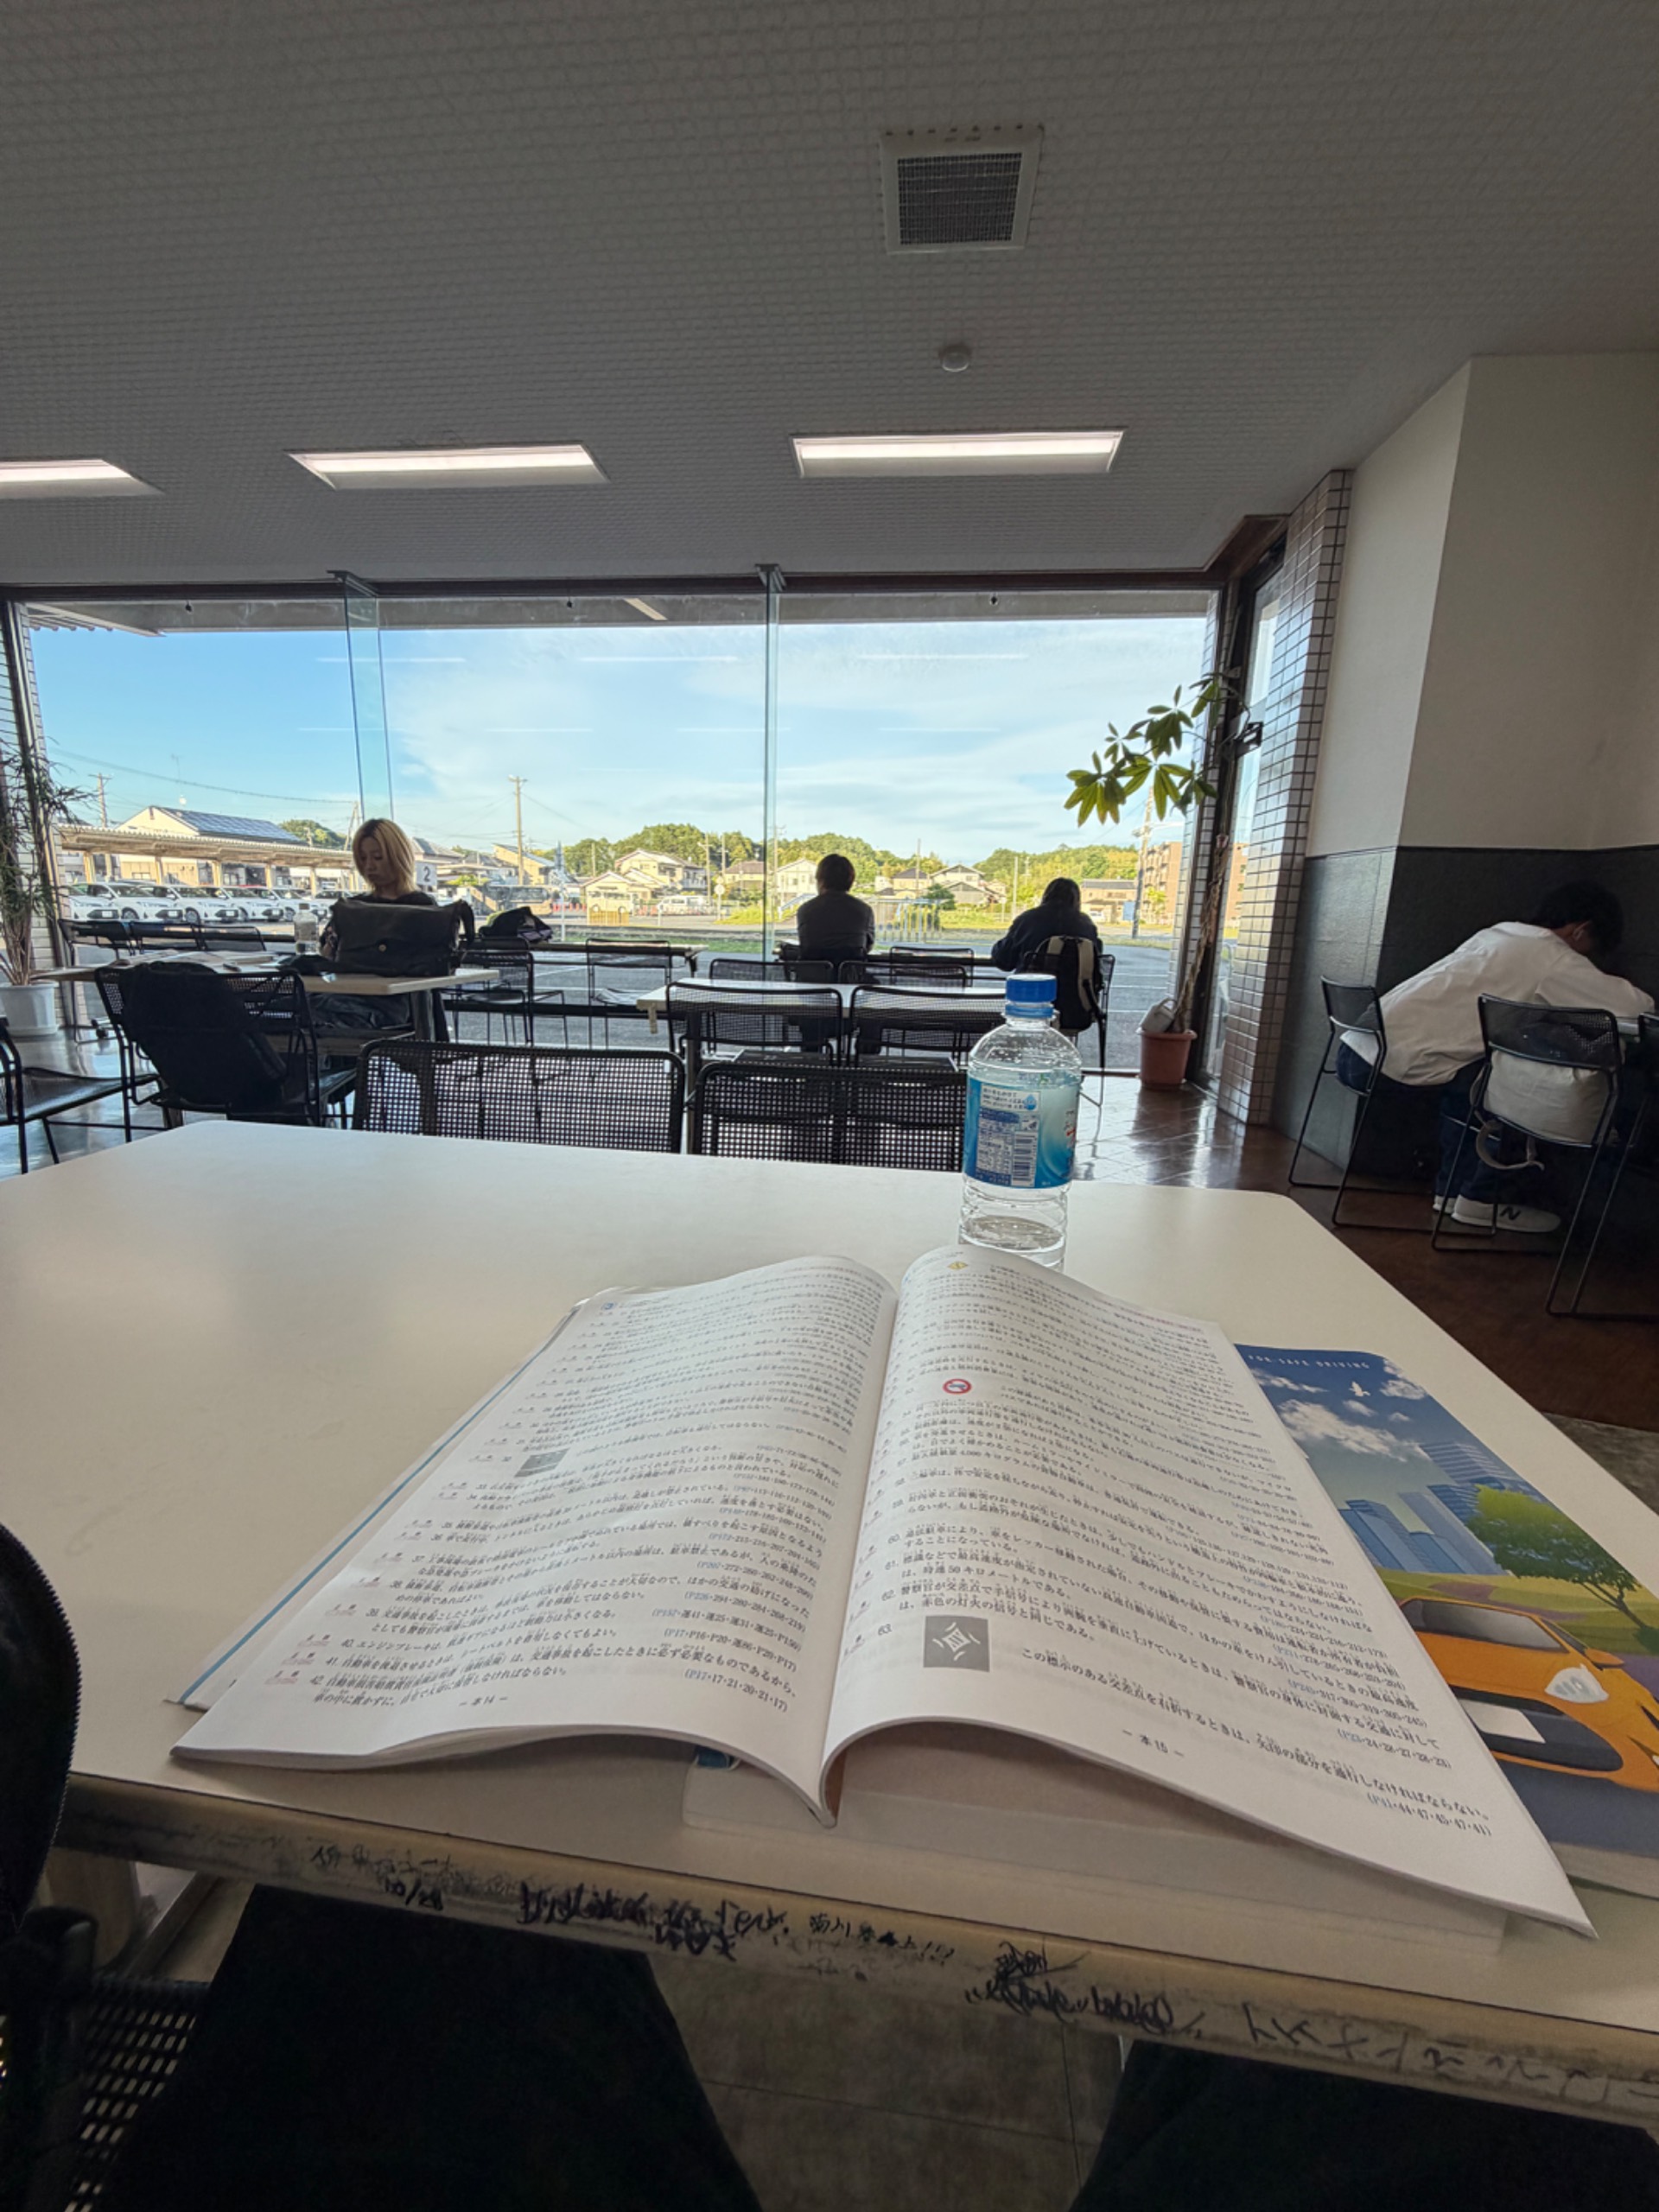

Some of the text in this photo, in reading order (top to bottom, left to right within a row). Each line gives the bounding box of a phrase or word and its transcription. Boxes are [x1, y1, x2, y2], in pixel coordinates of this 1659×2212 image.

[423, 866, 431, 882] 2
[1248, 1355, 1370, 1370] FOR SAFE DRIVING
